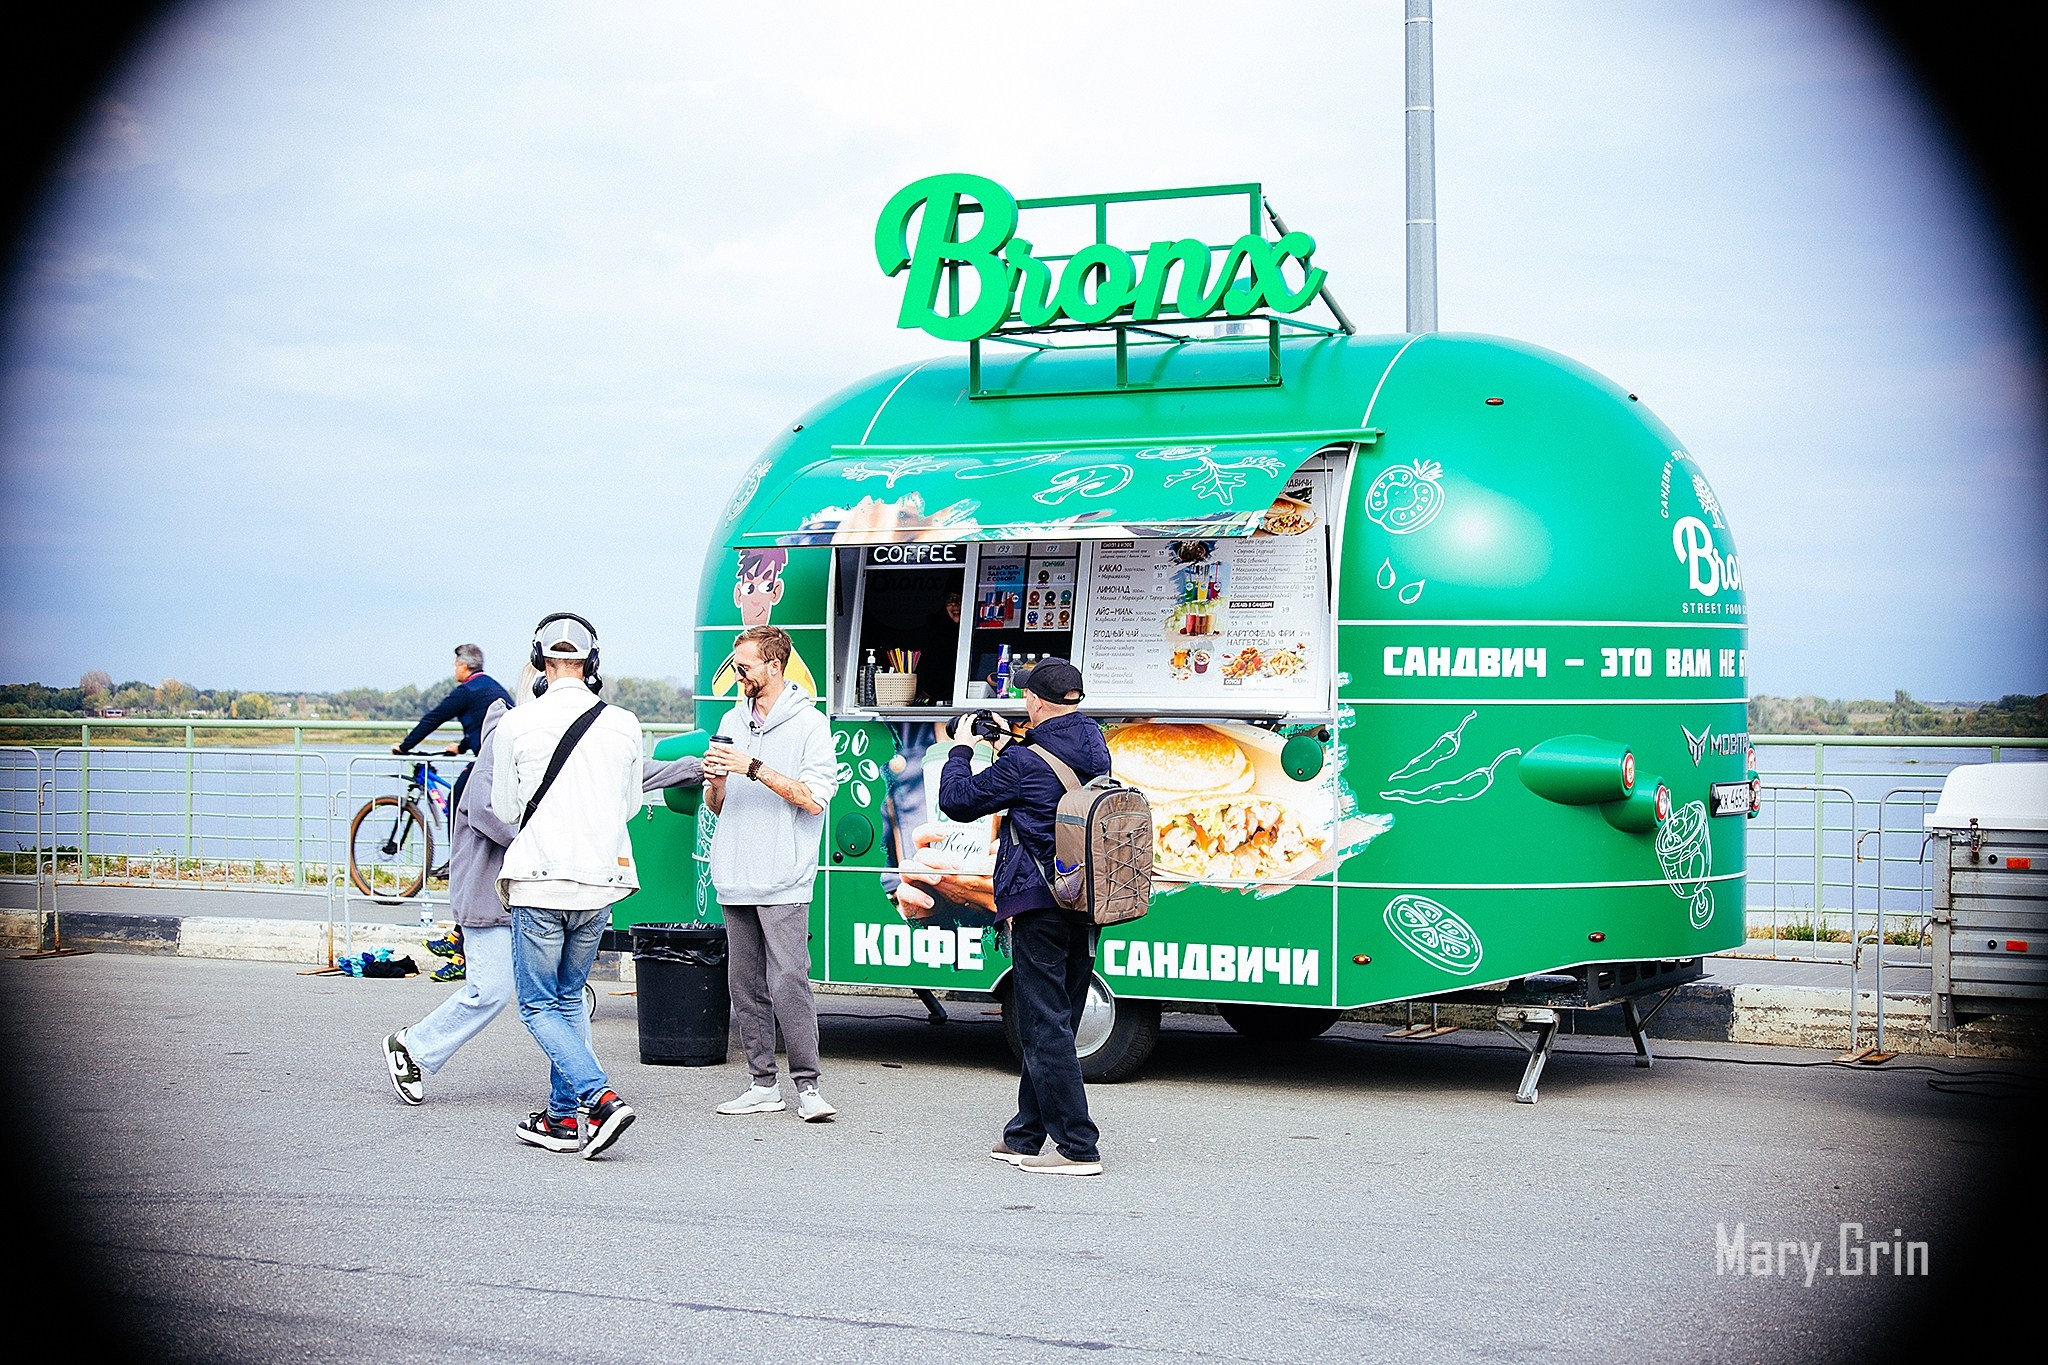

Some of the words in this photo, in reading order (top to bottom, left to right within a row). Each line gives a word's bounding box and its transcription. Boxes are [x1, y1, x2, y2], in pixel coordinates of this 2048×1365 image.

[874, 172, 1328, 342] Bronx
[873, 544, 957, 563] COFFEE
[1098, 563, 1122, 572] КАКАО
[1096, 585, 1130, 593] ЛИМОНАД
[1095, 606, 1134, 616] АЙС-МИЛК
[1682, 602, 1722, 614] STREET
[1092, 628, 1124, 638] ЯГОДНЫЙ
[1125, 627, 1140, 638] ЧАЙ
[1226, 629, 1276, 638] КАРТОФЕЛЬ
[1278, 629, 1296, 638] ФРИ
[1226, 638, 1270, 646] НАГГЕТСЫ
[1090, 661, 1105, 671] ЧАЙ
[1383, 646, 1547, 678] САНДВИЧ
[1600, 647, 1652, 678] ЭТО
[1665, 648, 1712, 678] ВАМ
[1718, 648, 1736, 678] НЕ
[936, 831, 983, 860] Кофе
[853, 922, 985, 971] КОФЕ
[1102, 938, 1319, 987] САНДВИЧИ
